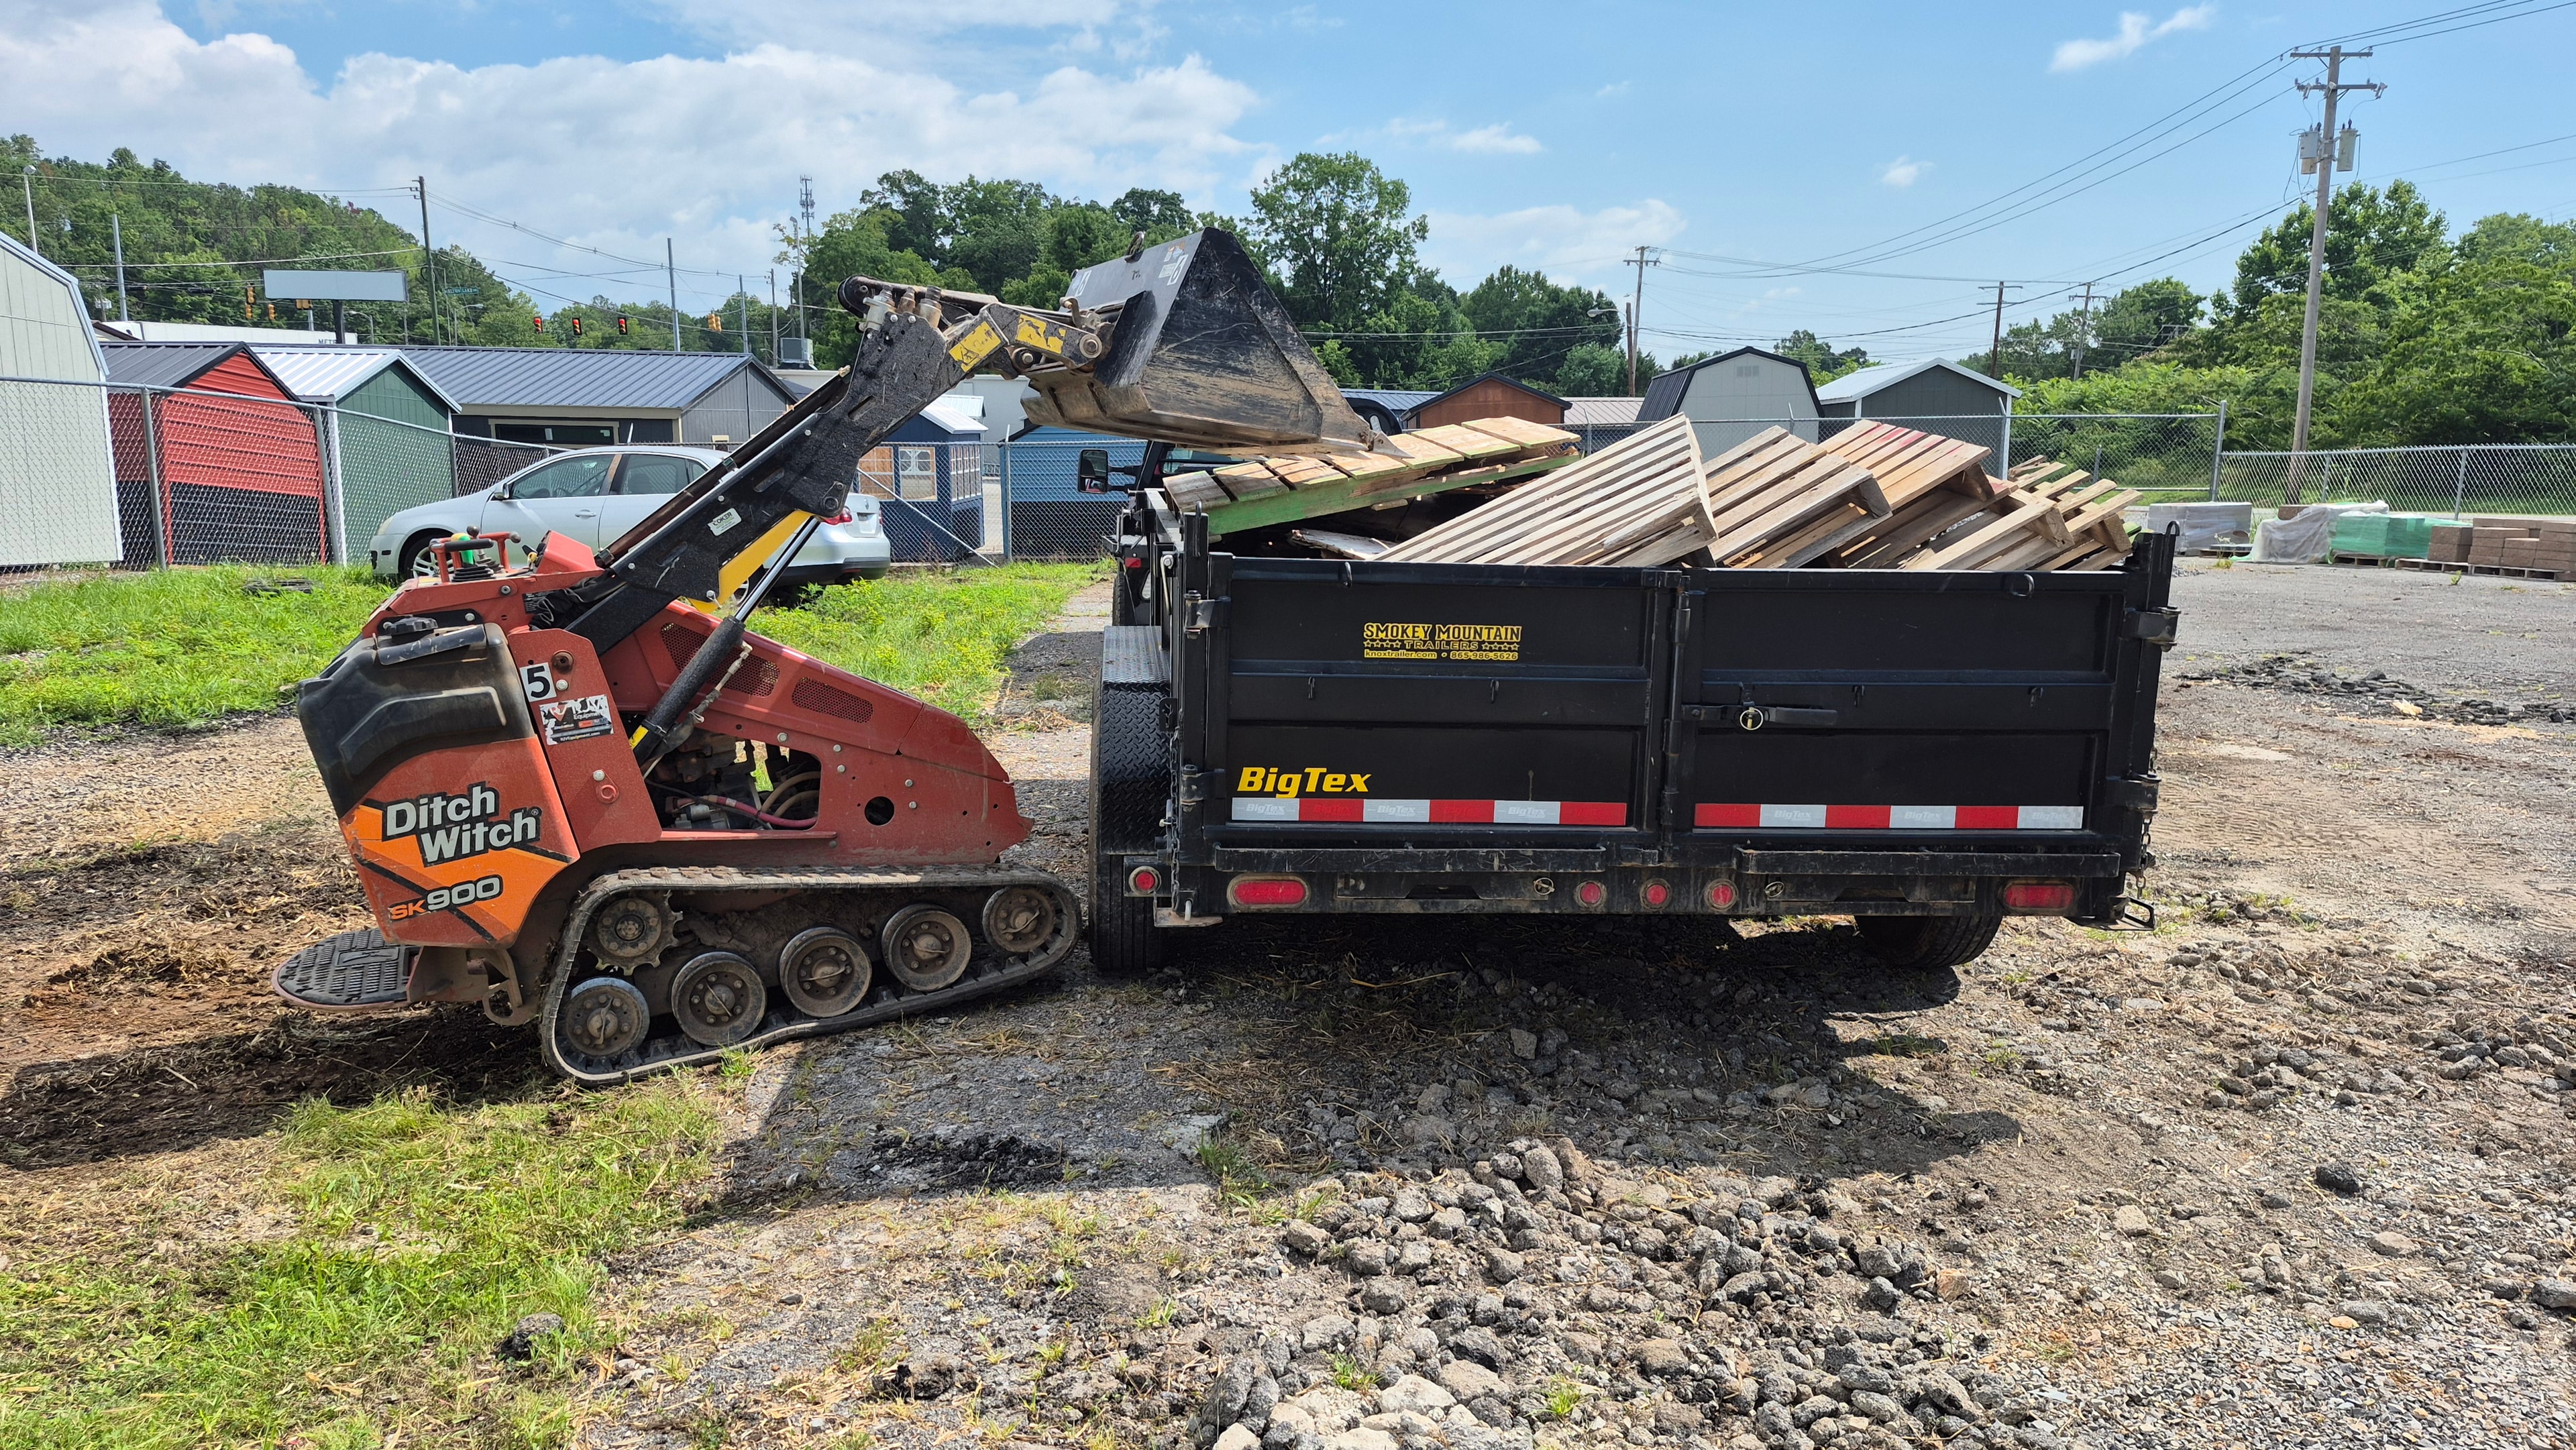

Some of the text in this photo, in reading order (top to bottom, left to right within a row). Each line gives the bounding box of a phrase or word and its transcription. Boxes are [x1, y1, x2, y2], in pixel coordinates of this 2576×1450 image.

[1364, 623, 1521, 642] SMOKEY MOUNTAIN
[1404, 640, 1479, 650] TRAILERS
[1365, 649, 1518, 660] knoxtrailer.com 865-986-5626
[527, 665, 550, 698] 5
[1237, 767, 1372, 798] BigTex
[386, 785, 495, 836] Ditch
[1246, 803, 1285, 814] BigTex
[1377, 805, 1416, 816] BigTex
[1507, 806, 1546, 817] BigTex
[1774, 810, 1812, 820] BigTex
[1904, 811, 1942, 821] BigTex
[421, 812, 537, 862] Witch
